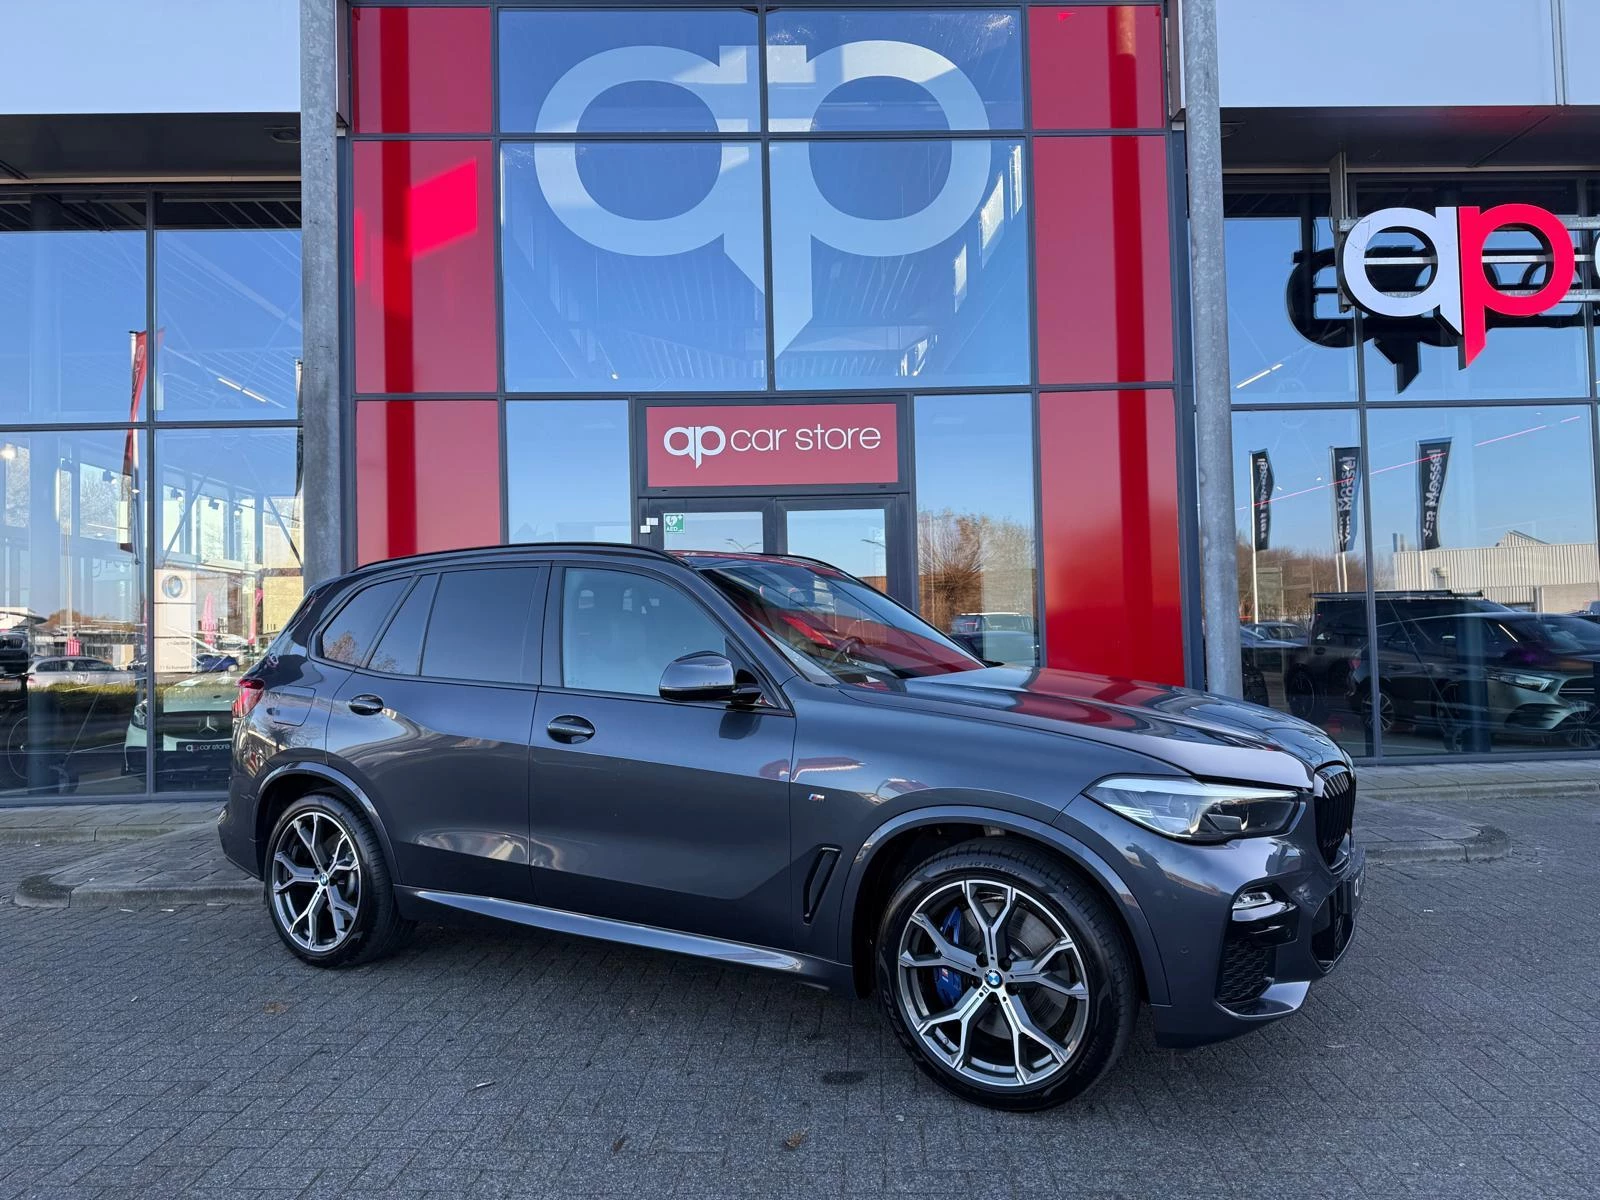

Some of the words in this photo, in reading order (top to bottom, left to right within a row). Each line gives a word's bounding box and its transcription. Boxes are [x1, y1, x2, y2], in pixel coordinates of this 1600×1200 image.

[1343, 203, 1575, 368] ap
[663, 425, 726, 469] ap
[730, 428, 787, 451] car
[795, 423, 881, 450] store
